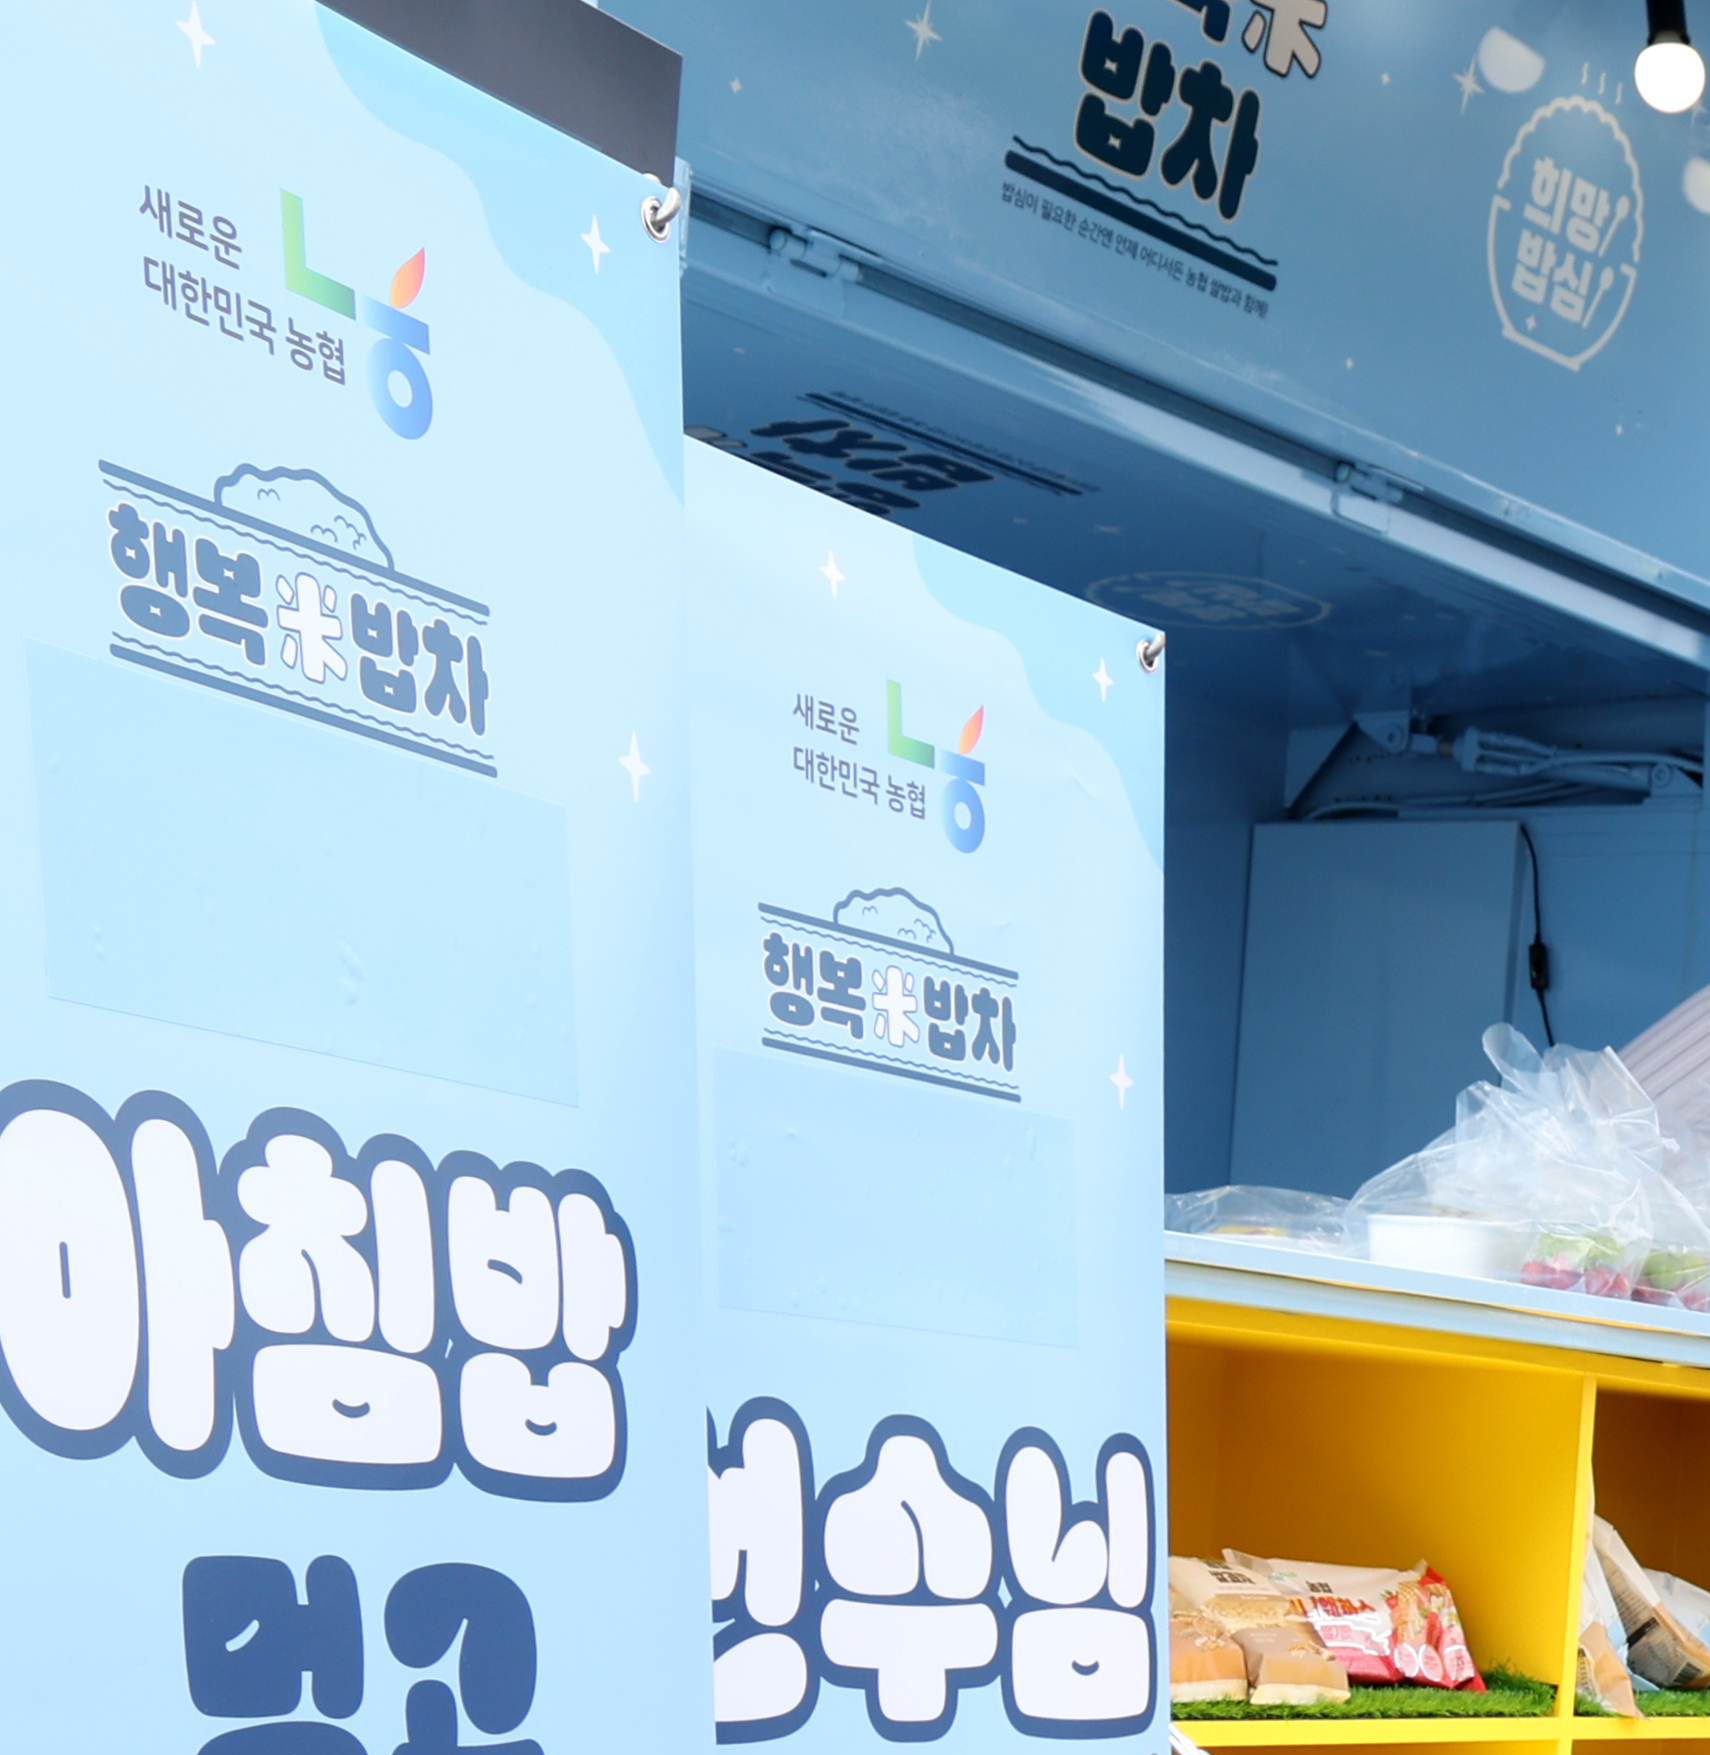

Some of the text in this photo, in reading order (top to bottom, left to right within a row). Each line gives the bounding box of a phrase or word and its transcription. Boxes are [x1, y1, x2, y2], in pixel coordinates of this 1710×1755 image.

[1075, 9, 1260, 221] 밥차
[139, 184, 243, 270] 새로운
[1001, 181, 1038, 213] 밥심이
[1041, 199, 1077, 232] 필요한
[1140, 245, 1184, 282] 어디서든
[1523, 156, 1611, 253] 희망
[142, 256, 347, 386] 대한민국 농협
[1511, 227, 1594, 323] 밥심
[792, 693, 860, 746] 새로운
[792, 746, 926, 820] 대한민국 농협
[0, 1079, 638, 1503] 아침밥
